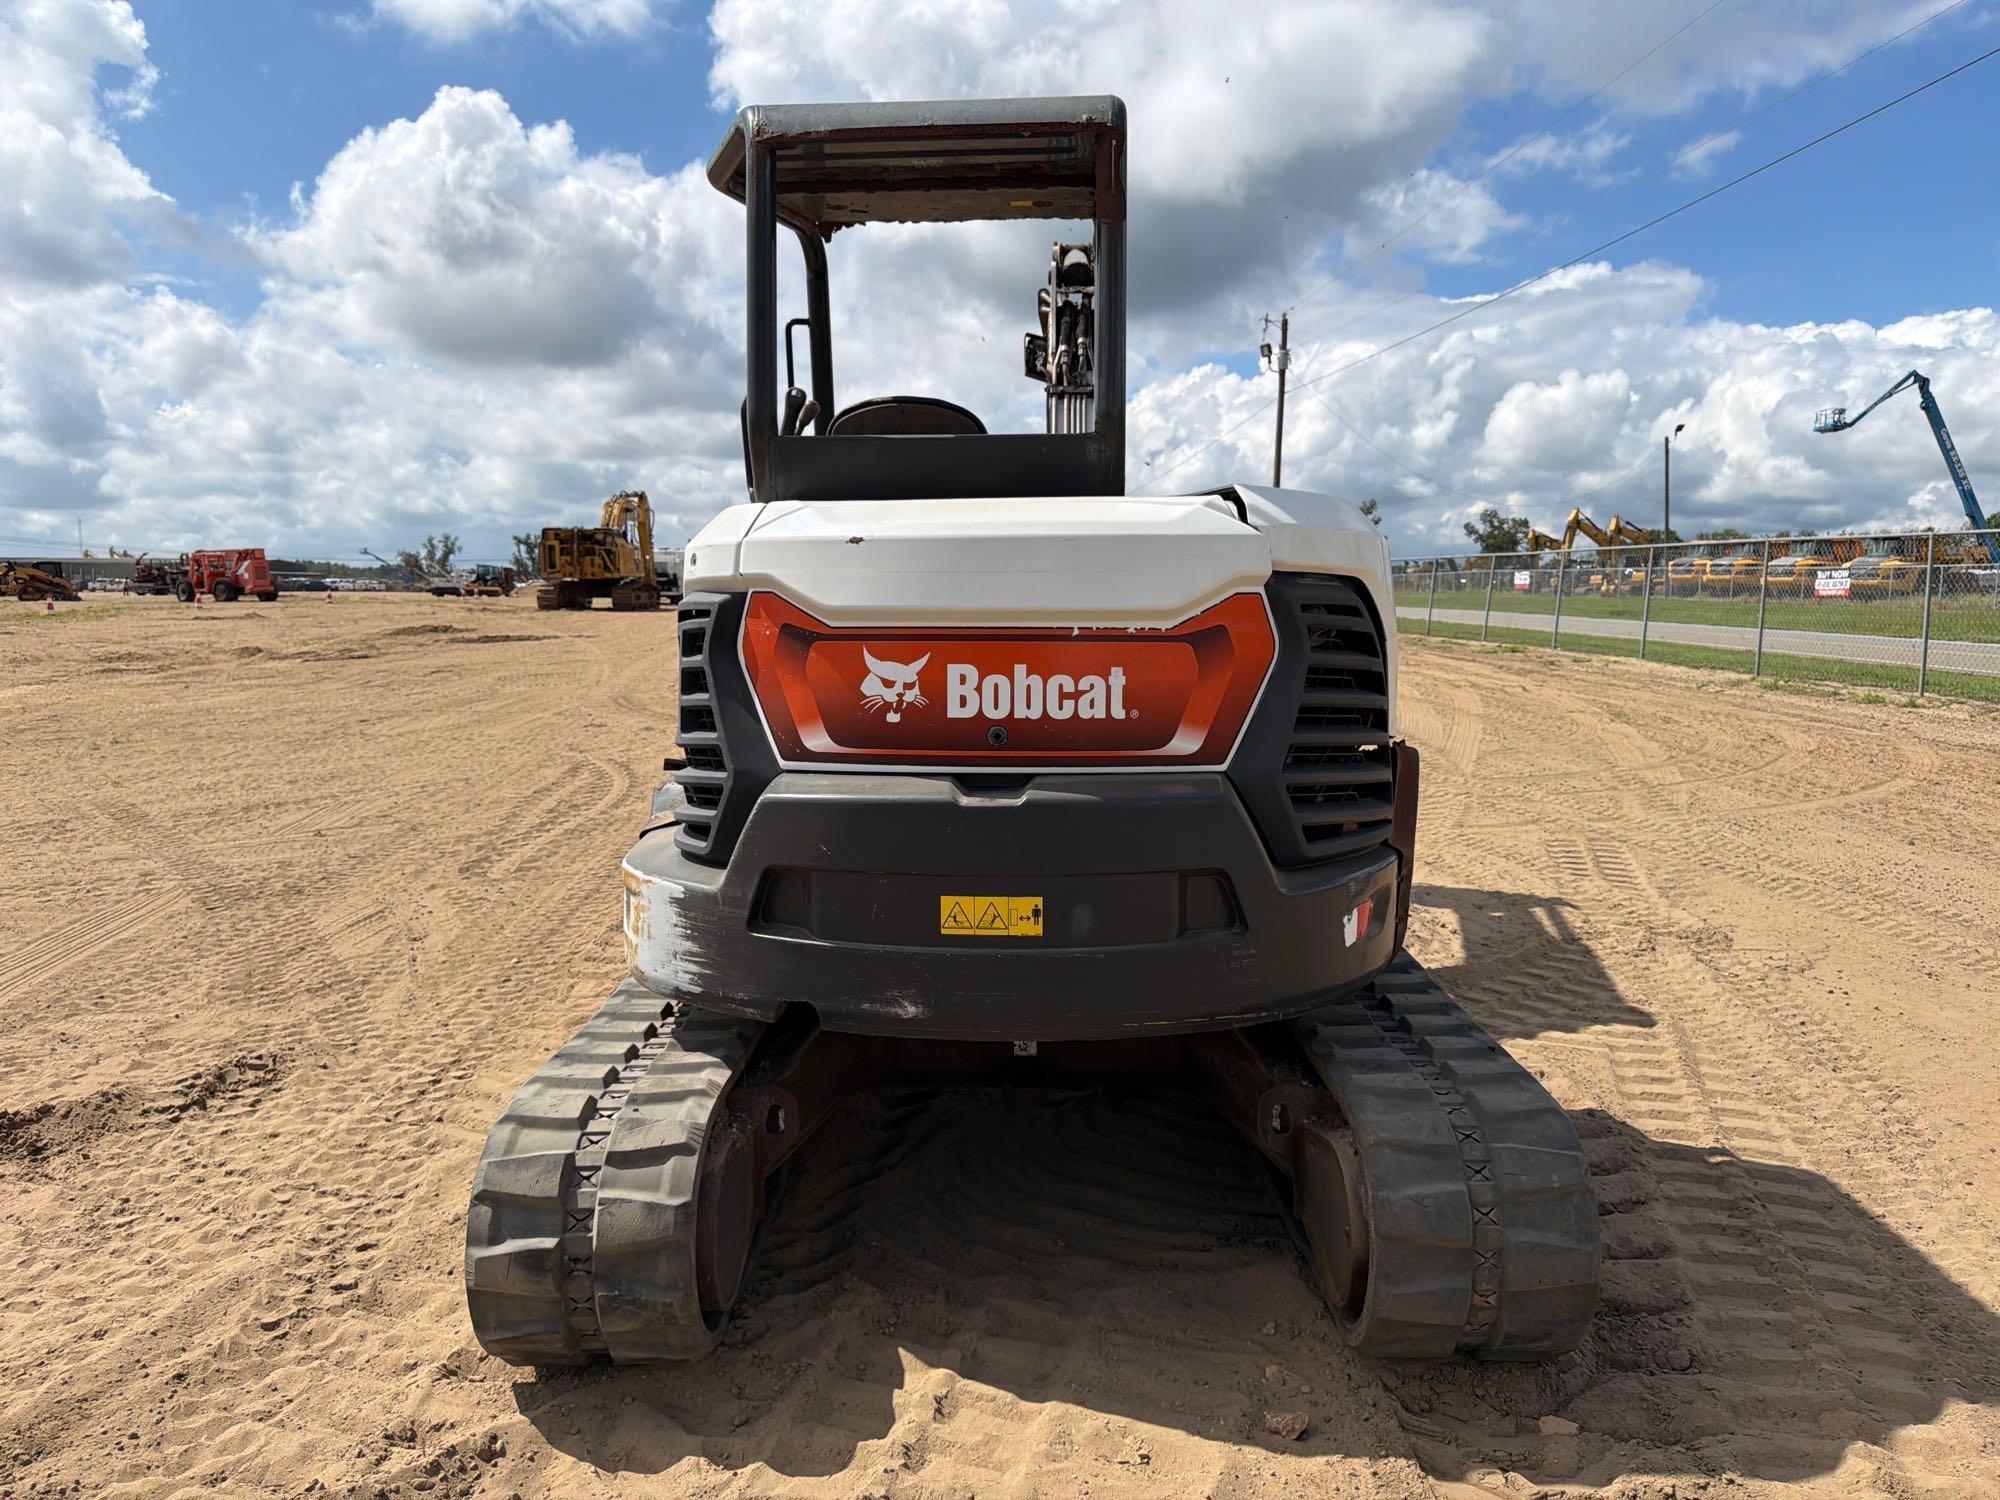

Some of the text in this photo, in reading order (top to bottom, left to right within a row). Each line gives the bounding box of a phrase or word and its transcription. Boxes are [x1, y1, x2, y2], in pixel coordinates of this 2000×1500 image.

[1817, 569, 1849, 579] BUY NOW
[946, 663, 1126, 720] Bobcat
